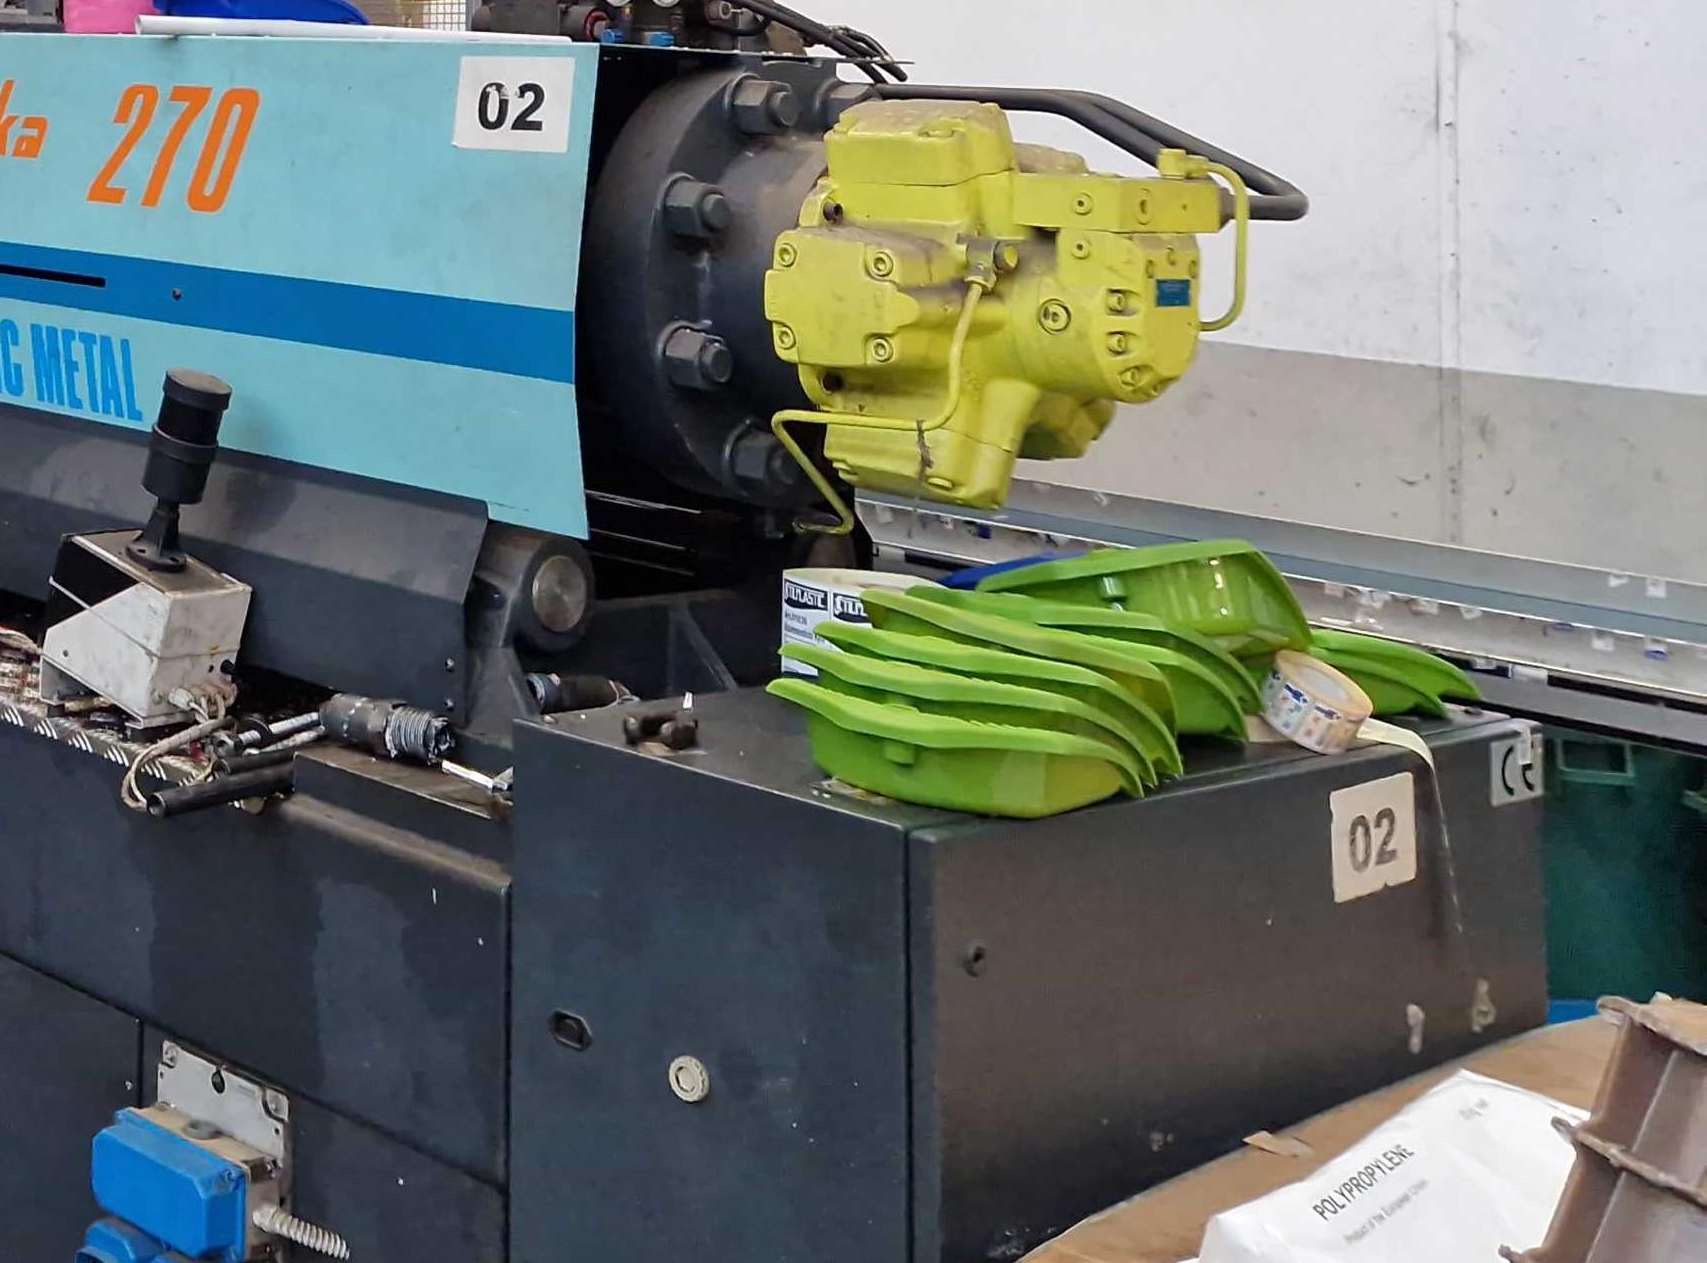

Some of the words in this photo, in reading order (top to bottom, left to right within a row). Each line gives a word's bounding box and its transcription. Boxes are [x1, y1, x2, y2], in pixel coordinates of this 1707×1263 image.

[478, 82, 545, 131] 02
[87, 83, 261, 213] 270
[30, 323, 144, 422] METAL
[1349, 807, 1397, 873] 02
[1312, 1144, 1415, 1221] POLYPROPYLENE
